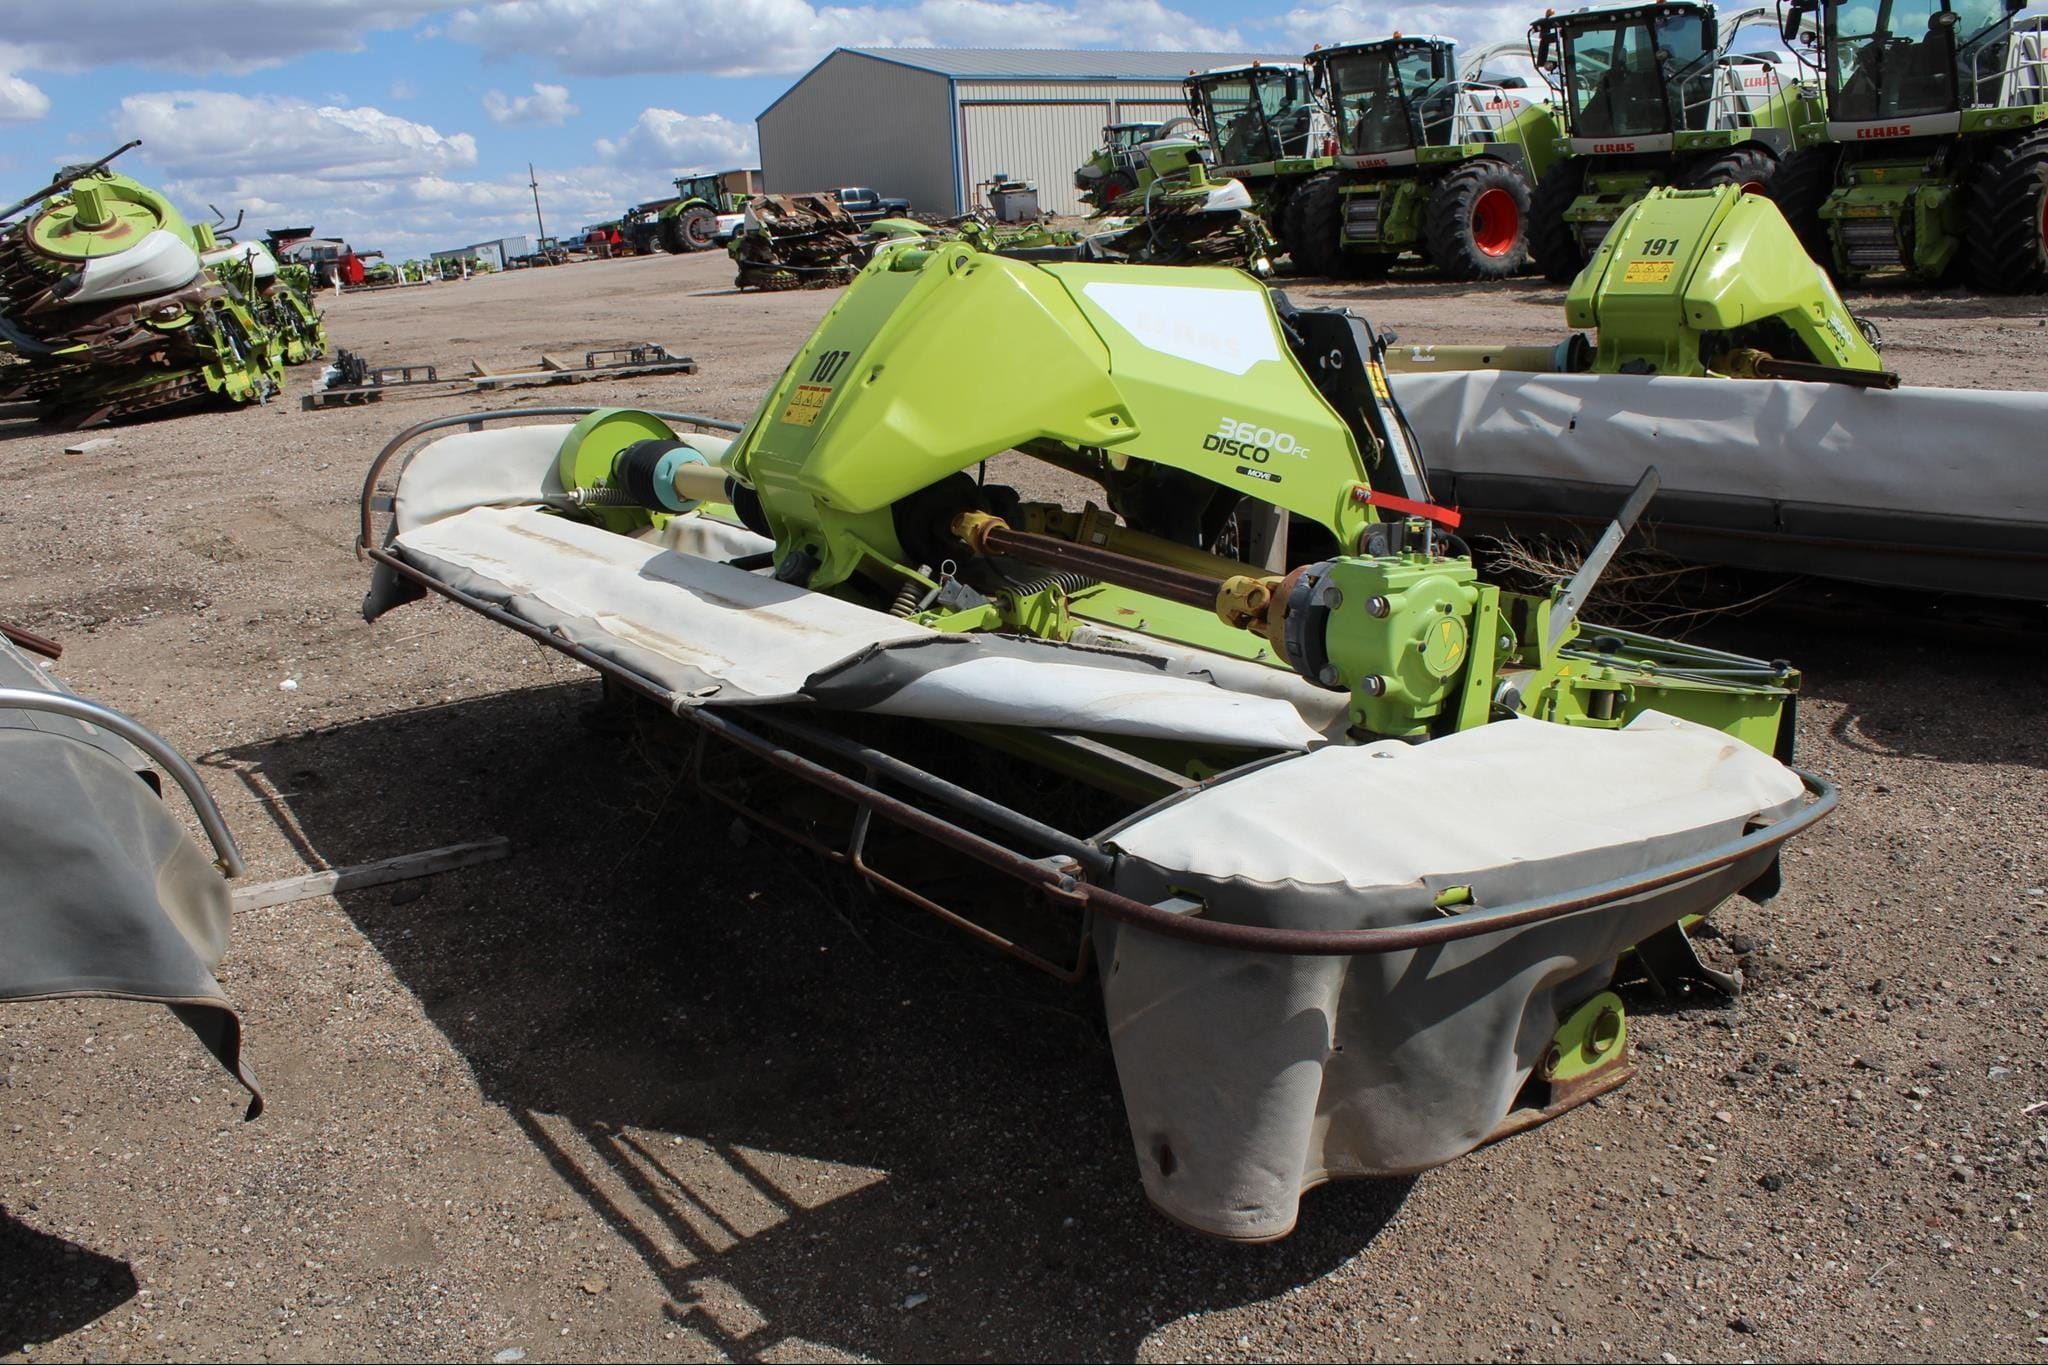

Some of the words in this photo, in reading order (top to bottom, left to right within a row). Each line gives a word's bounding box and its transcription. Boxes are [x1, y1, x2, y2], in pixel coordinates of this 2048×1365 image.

[1857, 125, 1911, 139] CLAAS
[1593, 143, 1635, 153] CLAAS
[1642, 239, 1680, 256] 191
[809, 350, 851, 383] 107
[1202, 434, 1270, 464] DISCO
[1247, 469, 1271, 480] MOVE
